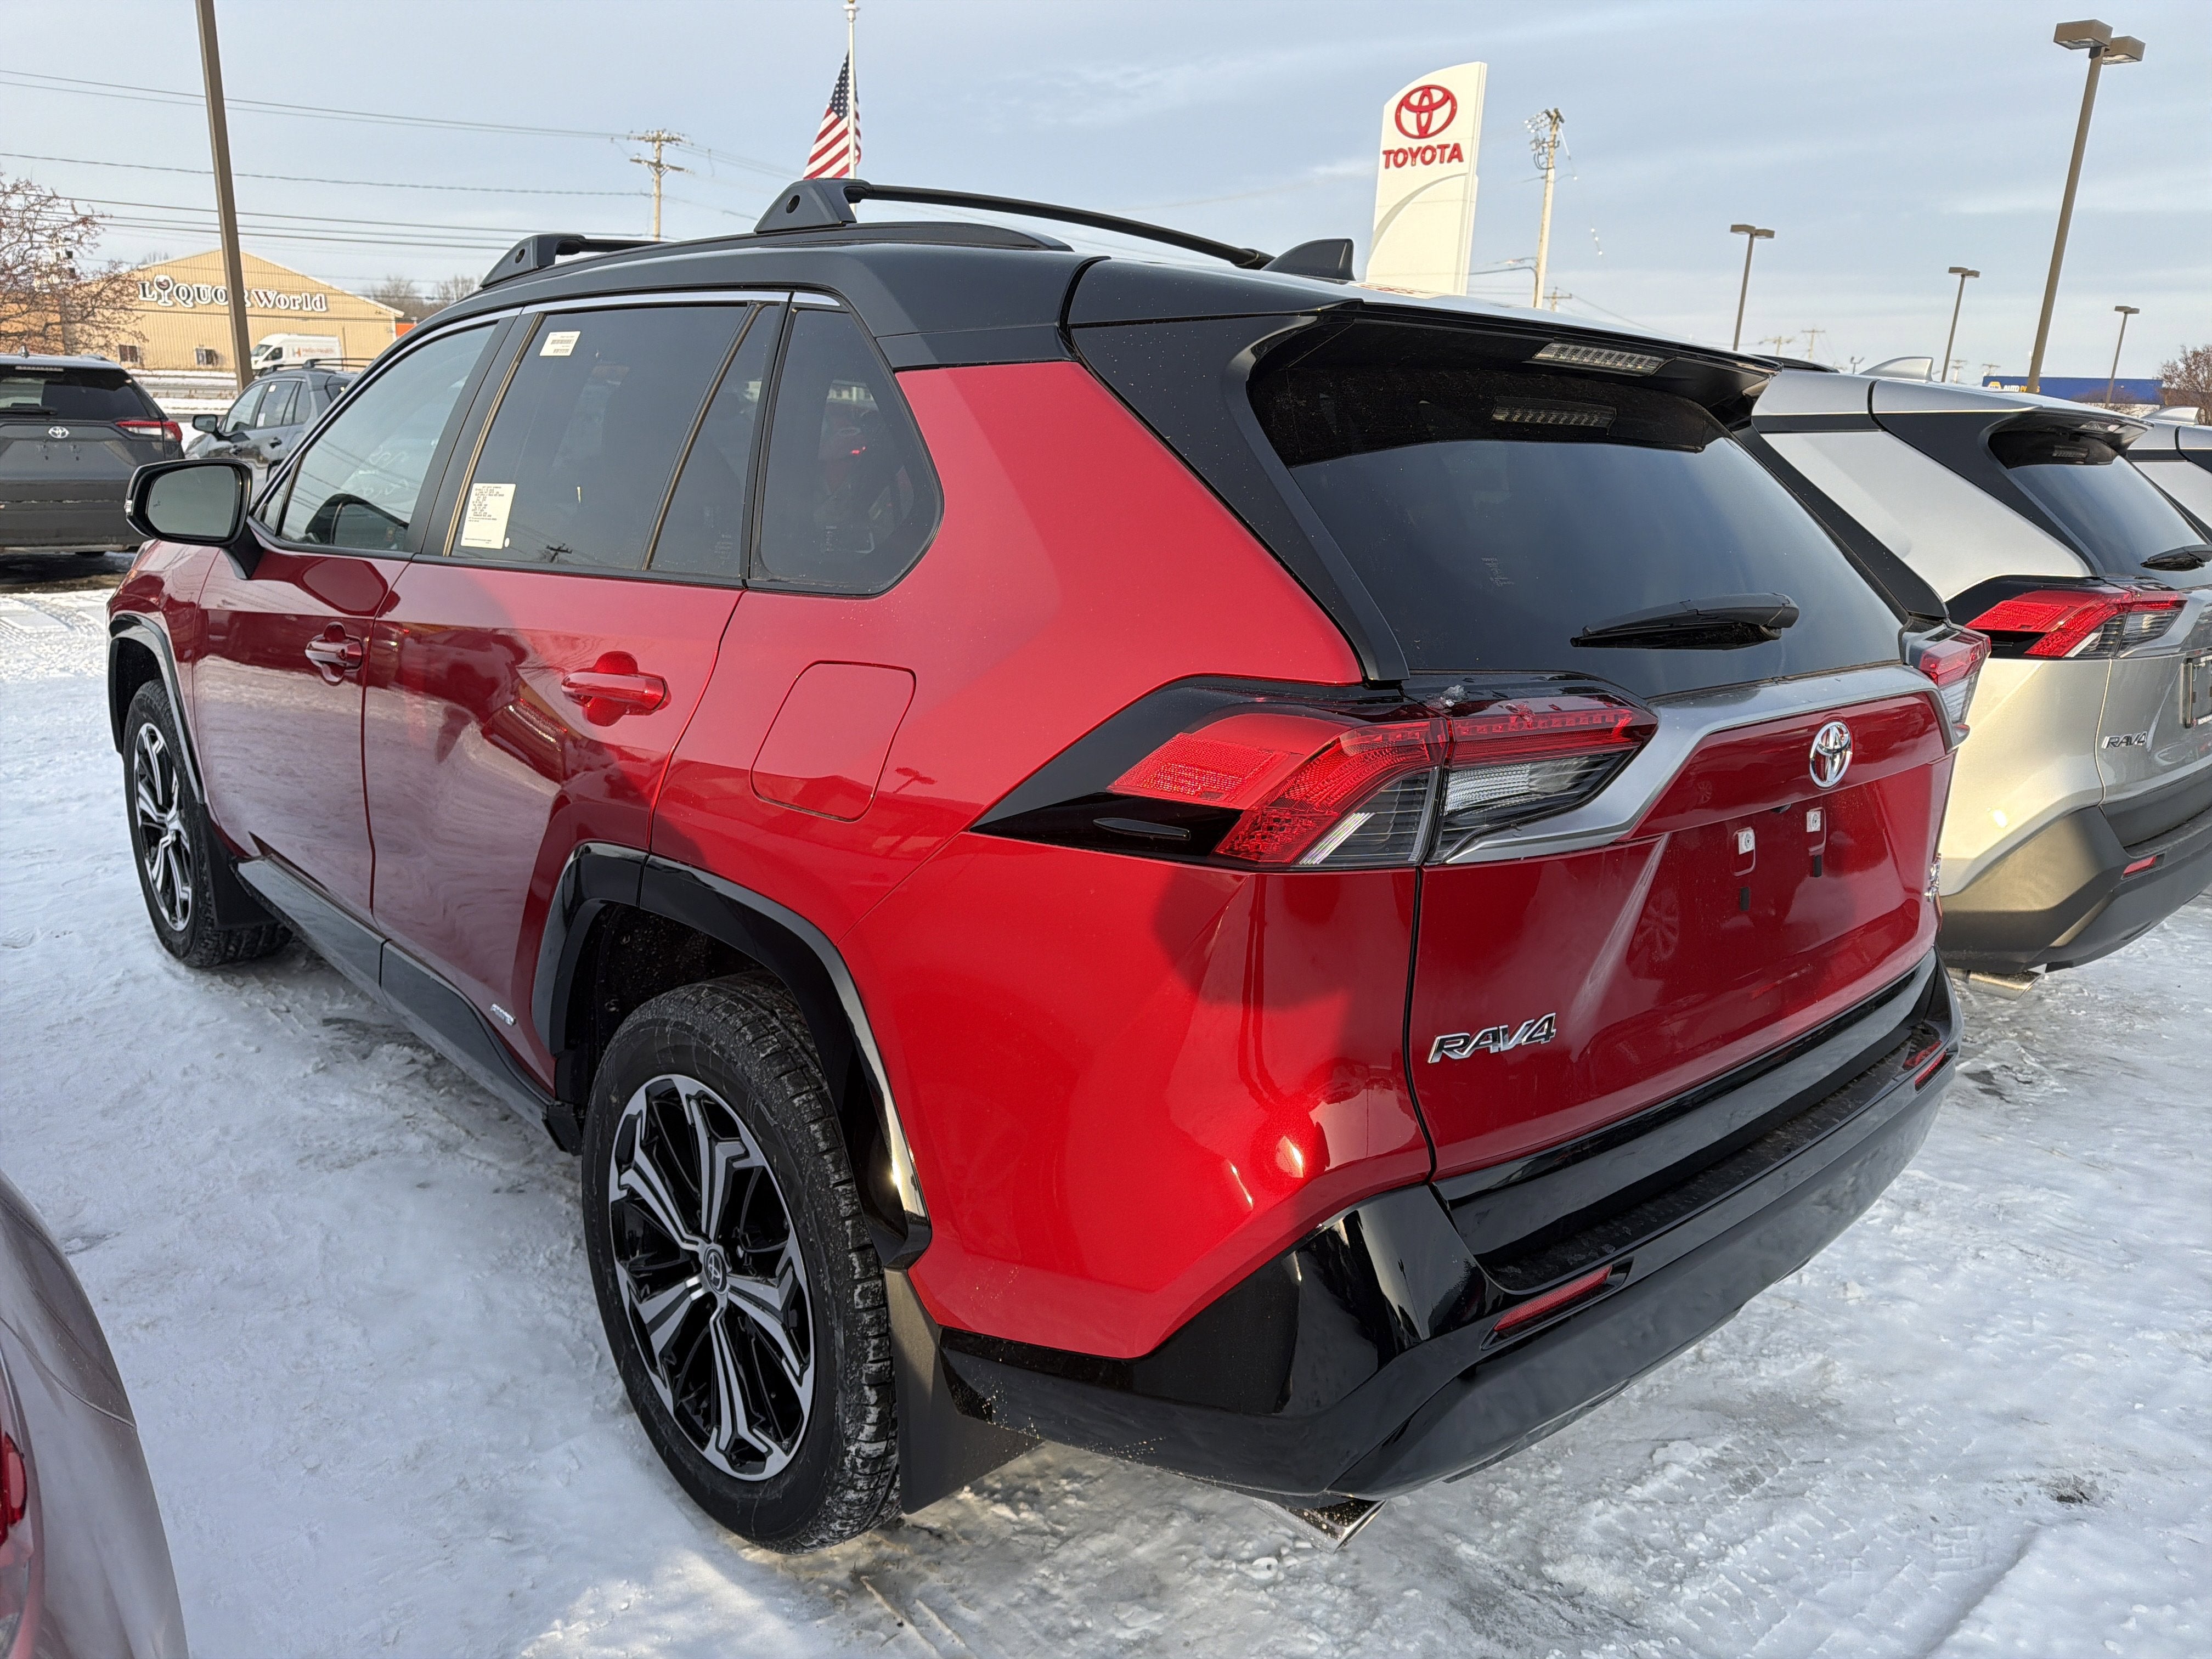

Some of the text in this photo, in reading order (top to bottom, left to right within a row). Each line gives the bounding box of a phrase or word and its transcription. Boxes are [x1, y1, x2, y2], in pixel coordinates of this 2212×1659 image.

[1382, 143, 1464, 170] TOYOTA
[137, 275, 327, 312] LIQUO World
[2101, 731, 2148, 749] RAV4
[1427, 1012, 1556, 1064] RAV4
